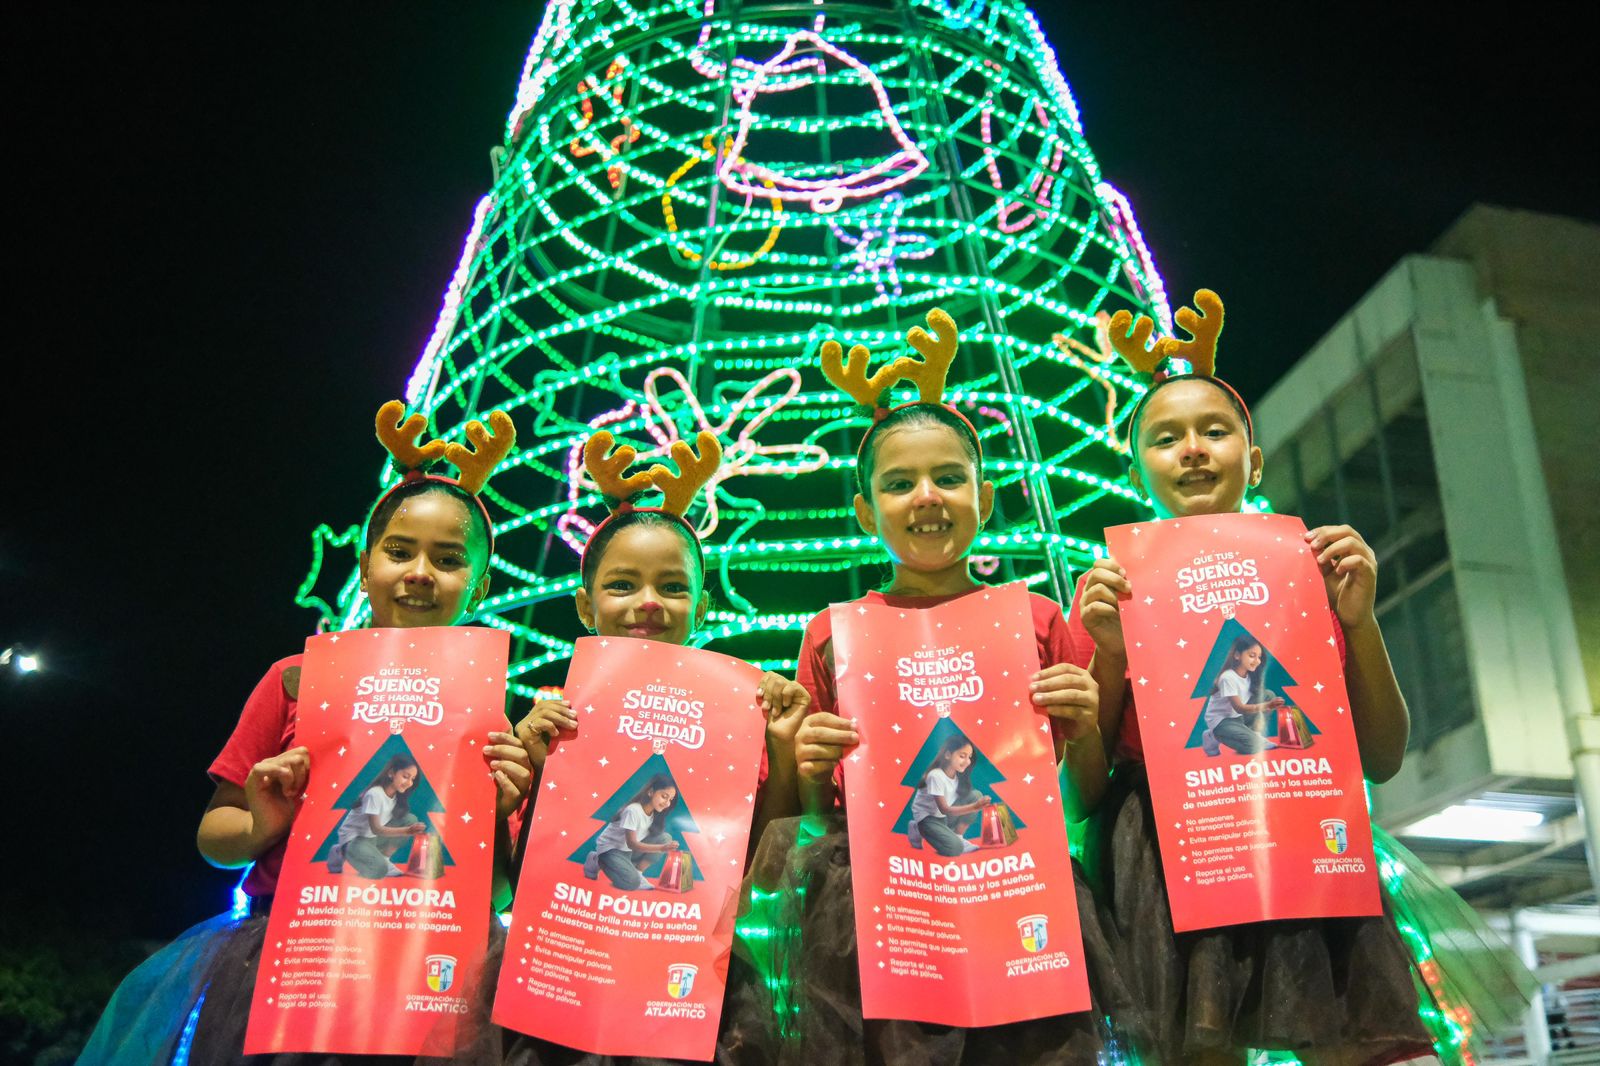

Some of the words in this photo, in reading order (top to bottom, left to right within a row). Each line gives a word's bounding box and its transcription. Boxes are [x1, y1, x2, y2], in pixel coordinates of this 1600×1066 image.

[1193, 555, 1213, 565] QUE
[1215, 552, 1234, 560] TUS
[1178, 559, 1258, 589] SUEÑOS
[1196, 584, 1209, 593] SE
[1211, 578, 1245, 589] HAGAN
[1180, 582, 1270, 614] REALIDAD
[914, 650, 934, 659] QUE
[936, 647, 955, 656] TUS
[898, 651, 975, 677] SUEÑOS
[357, 676, 441, 696] SUEÑOS
[929, 674, 963, 685] HAGAN
[647, 684, 667, 693] QUE
[669, 687, 687, 697] TUS
[898, 675, 984, 707] REALIDAD
[352, 702, 444, 726] REALIDAD
[624, 690, 705, 719] SUEÑOS
[638, 711, 651, 719] SE
[653, 713, 687, 725] HAGAN
[617, 715, 705, 749] REALIDAD
[1185, 767, 1225, 787] SIN
[1230, 758, 1333, 781] PÓLVORA
[1187, 790, 1196, 798] la
[1198, 785, 1234, 797] Navidad
[1262, 781, 1279, 789] más
[1282, 781, 1287, 789] y
[1288, 778, 1300, 787] los
[1303, 777, 1332, 786] sueños
[1183, 801, 1195, 810] de
[1197, 796, 1236, 808] nuestros
[1264, 792, 1291, 800] nunca
[1293, 790, 1303, 798] se
[1305, 789, 1343, 799] apagarán
[889, 856, 924, 877] SIN
[930, 852, 1036, 882] PÓLVORA
[1314, 863, 1366, 874] ATLÁNTICO
[884, 887, 895, 896] de
[898, 889, 933, 902] nuestros
[935, 895, 957, 904] niños
[960, 895, 989, 904] nunca
[991, 891, 1001, 900] se
[1004, 882, 1046, 898] apagarán
[890, 876, 898, 885] la
[900, 877, 932, 890] Navidad
[935, 884, 955, 893] brilla
[958, 883, 977, 893] más
[979, 884, 984, 892] y
[987, 880, 1000, 889] los
[1002, 873, 1034, 885] sueños
[300, 886, 338, 905] SIN
[346, 884, 456, 908] PÓLVORA
[554, 882, 593, 907] SIN
[598, 894, 702, 920] PÓLVORA
[297, 908, 305, 916] la
[308, 907, 345, 915] Navidad
[374, 908, 392, 917] más
[395, 911, 401, 919] y
[403, 909, 417, 918] los
[551, 901, 559, 910] la
[561, 902, 597, 920] Navidad
[599, 914, 621, 926] brilla
[623, 919, 641, 928] más
[644, 921, 649, 930] y
[651, 921, 664, 929] los
[666, 921, 697, 931] sueños
[289, 920, 300, 928] de
[302, 919, 342, 927] nuestros
[405, 922, 416, 930] se
[542, 911, 552, 920] de
[556, 914, 593, 931] nuestros
[596, 924, 620, 936] niños
[622, 930, 649, 939] nunca
[652, 932, 662, 940] se
[664, 932, 705, 943] apagarán
[1008, 958, 1070, 977] ATLÁNTICO
[405, 1000, 468, 1014] ATLÁNTICO
[645, 1006, 706, 1019] ATLÁNTICO
